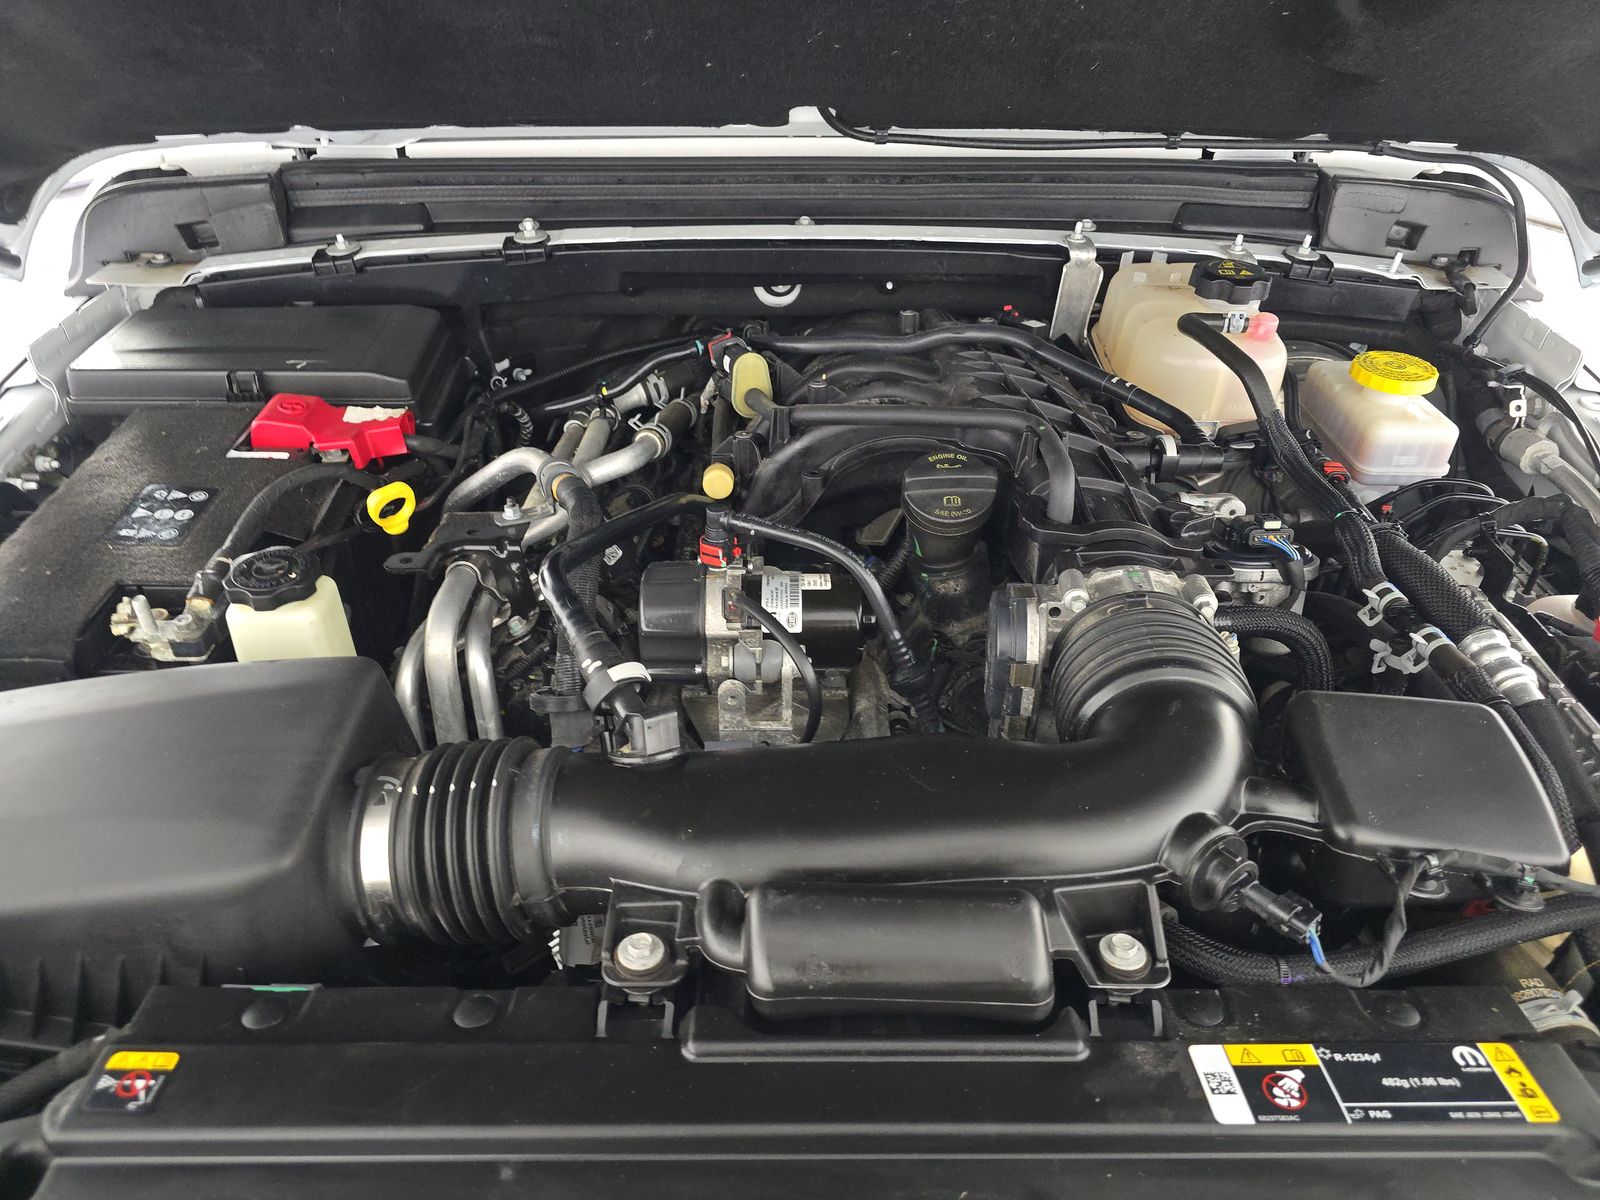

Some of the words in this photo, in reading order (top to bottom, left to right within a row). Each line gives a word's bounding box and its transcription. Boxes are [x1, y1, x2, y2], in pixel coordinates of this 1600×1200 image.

[928, 453, 955, 462] ENGINE
[956, 454, 968, 462] OIL
[934, 508, 949, 516] SAE
[1519, 977, 1545, 988] RAD
[1333, 1052, 1381, 1064] R-1234yf
[1368, 1110, 1392, 1119] PAG
